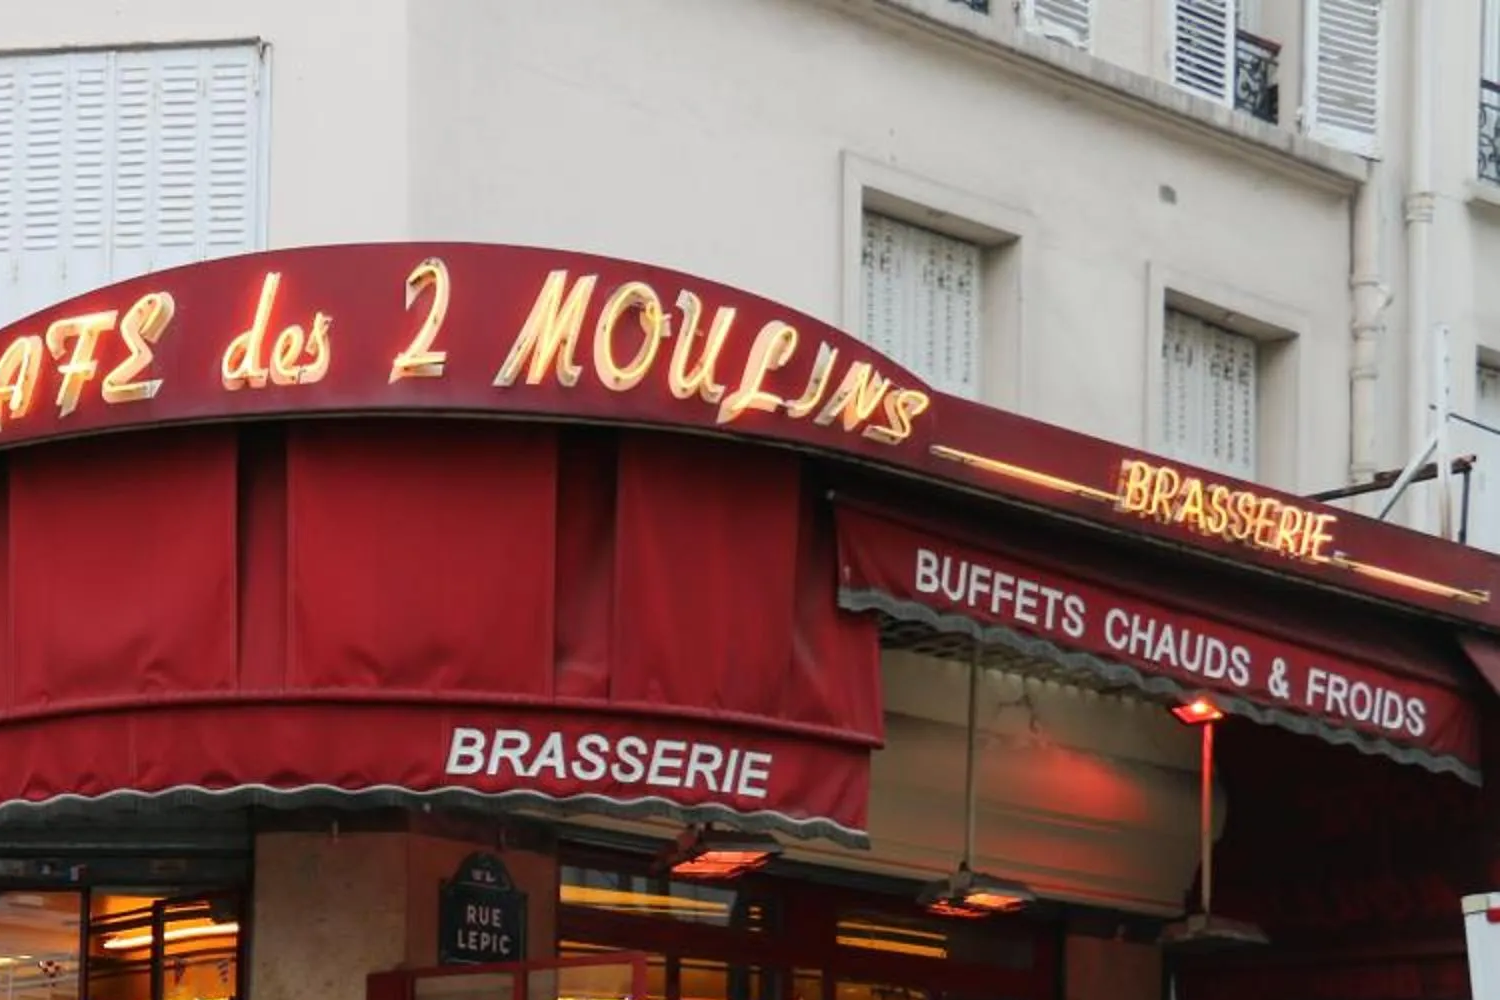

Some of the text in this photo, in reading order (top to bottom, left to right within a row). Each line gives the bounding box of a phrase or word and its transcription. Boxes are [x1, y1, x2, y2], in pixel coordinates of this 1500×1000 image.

[222, 272, 332, 390] des
[389, 257, 449, 383] 2
[493, 269, 930, 445] MOULINS
[1113, 459, 1337, 564] BRASSERIE
[915, 548, 1426, 736] BUFFETS CHAUDS & FROIDS
[446, 727, 773, 799] BRASSERIE
[457, 928, 511, 955] LEPIC
[467, 904, 502, 928] RUE
